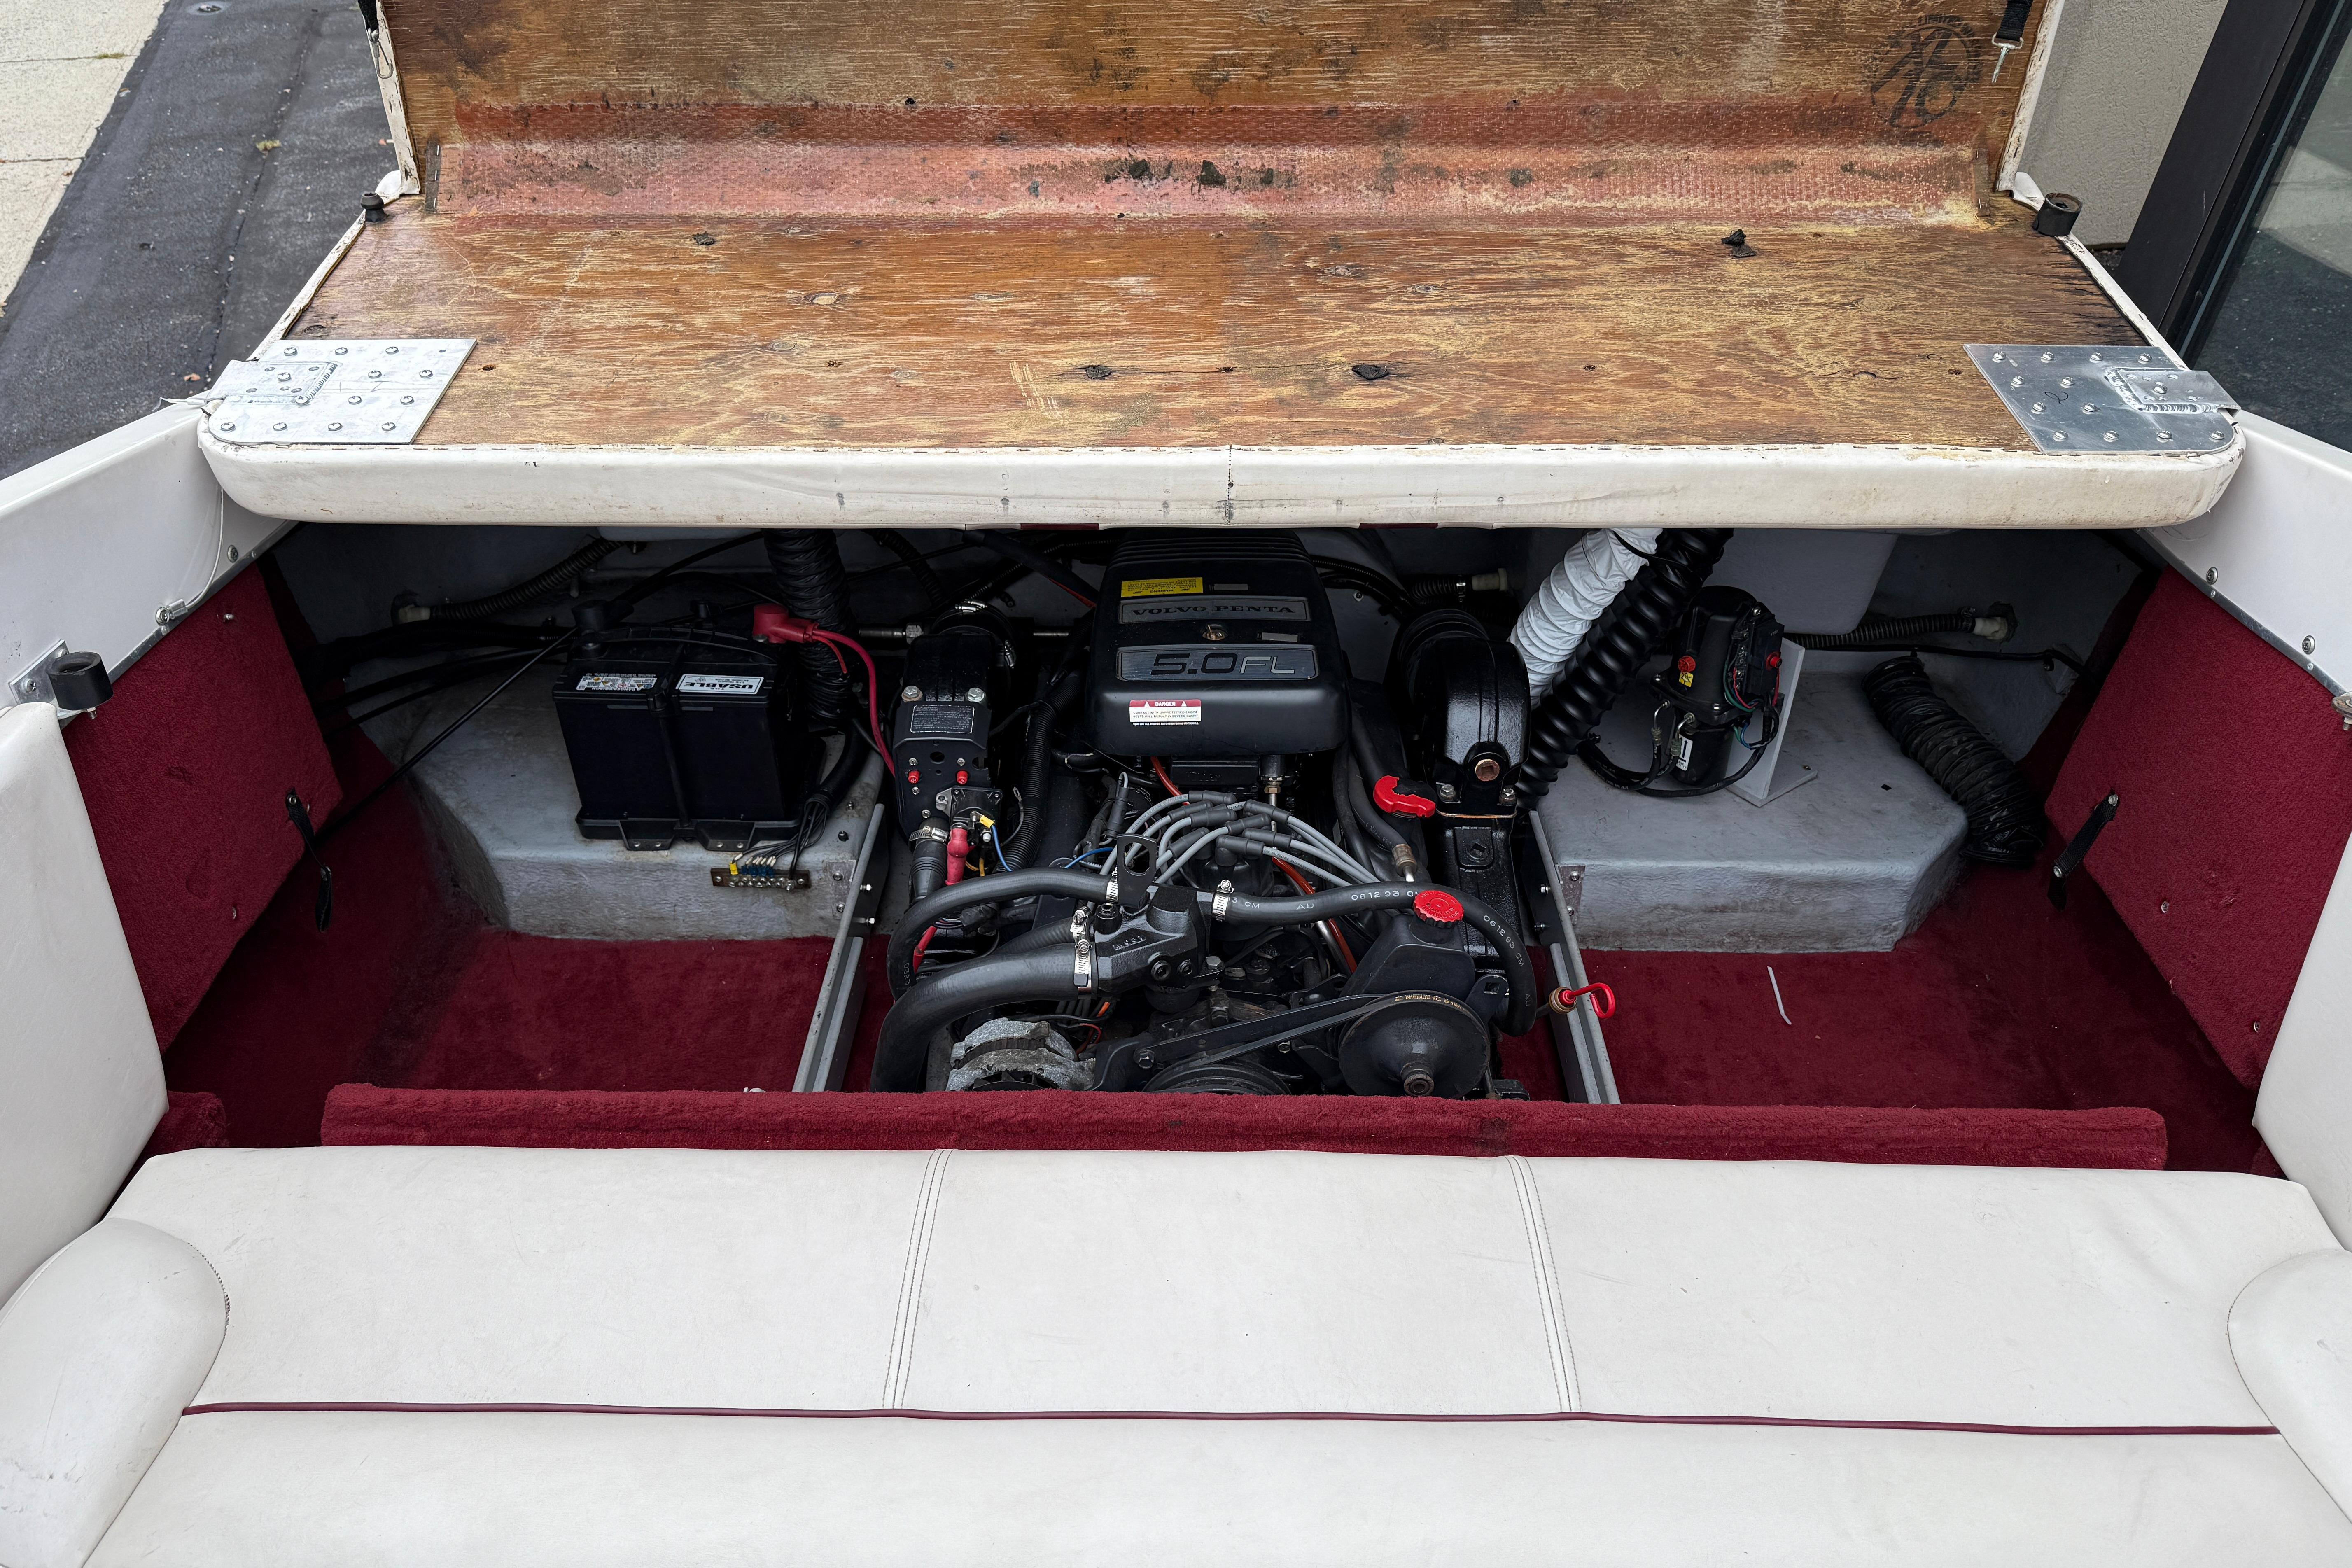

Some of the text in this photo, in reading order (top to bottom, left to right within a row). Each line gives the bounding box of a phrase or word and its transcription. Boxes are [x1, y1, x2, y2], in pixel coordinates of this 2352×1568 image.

[1131, 606, 1209, 616] VOLVO
[1271, 852, 1289, 861] SILICONE
[1351, 891, 1380, 901] 0612
[1483, 915, 1531, 1006] 0612 93 CM AU
